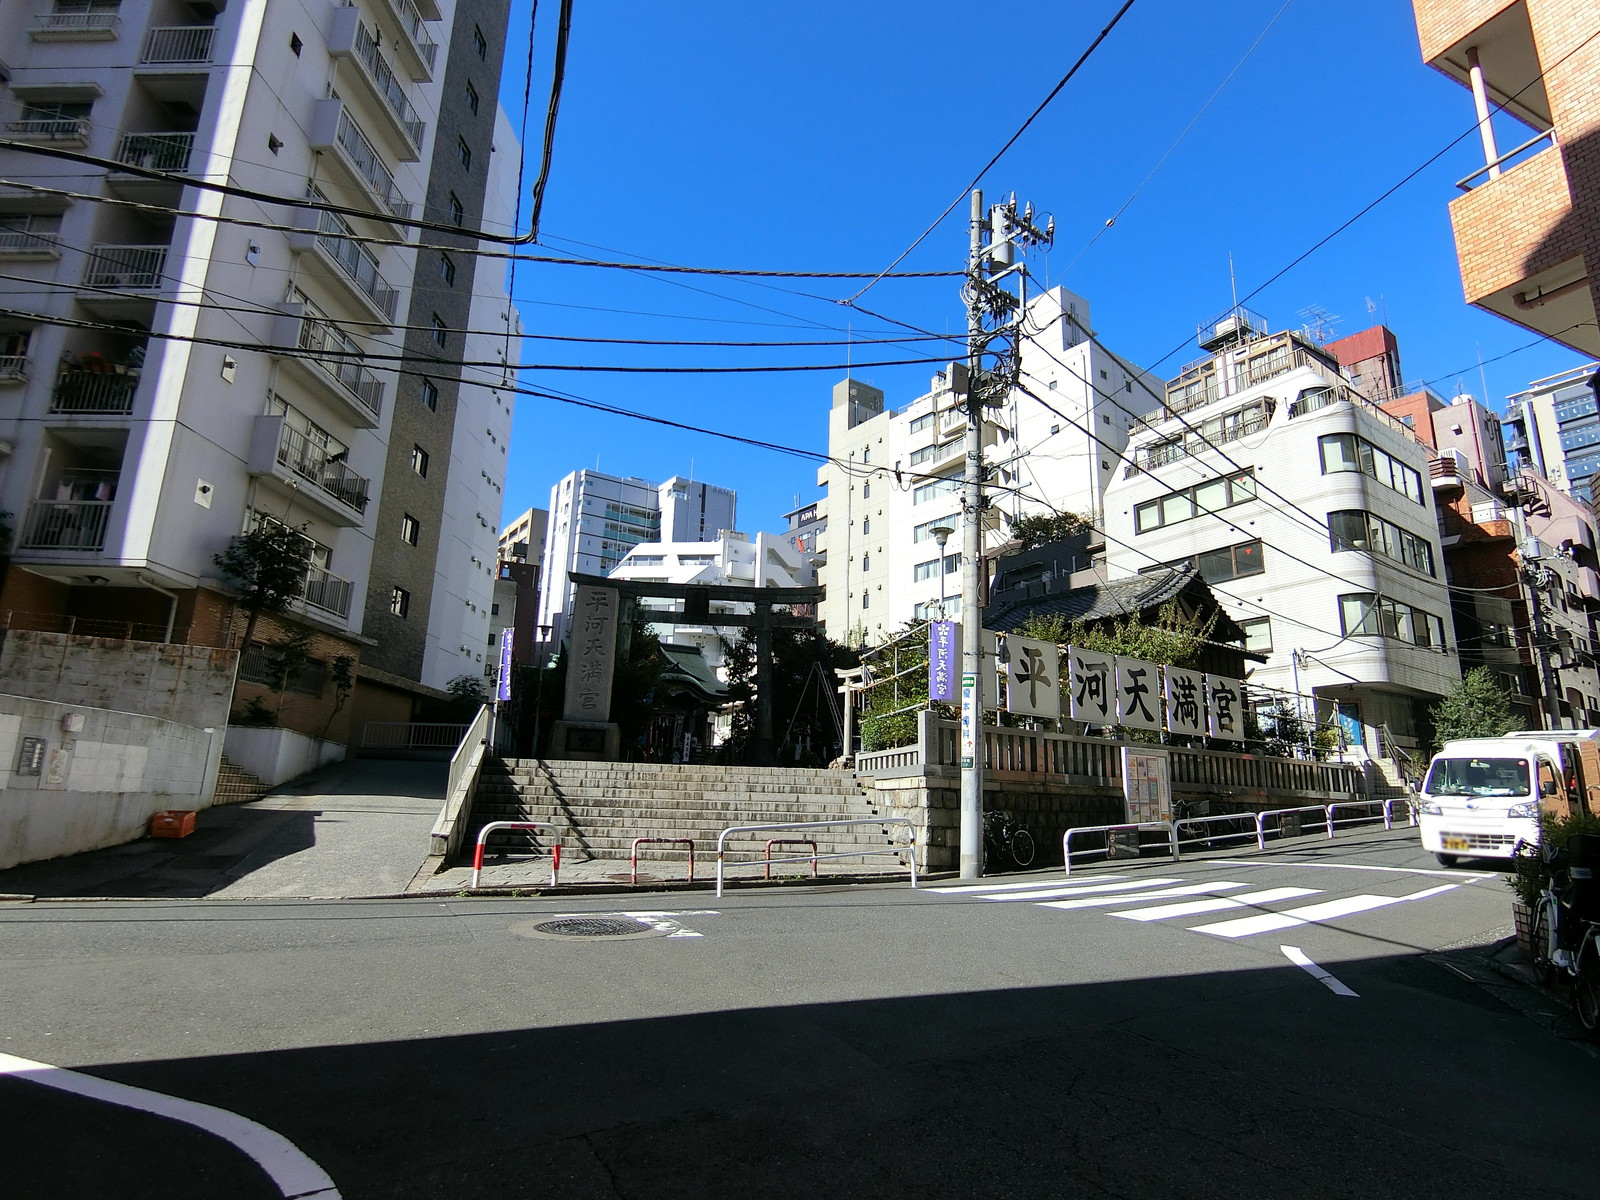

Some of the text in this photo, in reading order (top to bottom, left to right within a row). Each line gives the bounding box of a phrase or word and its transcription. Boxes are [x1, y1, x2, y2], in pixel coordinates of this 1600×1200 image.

[579, 591, 609, 711] 平河天満宮
[1015, 646, 1237, 734] 平河天満宮
